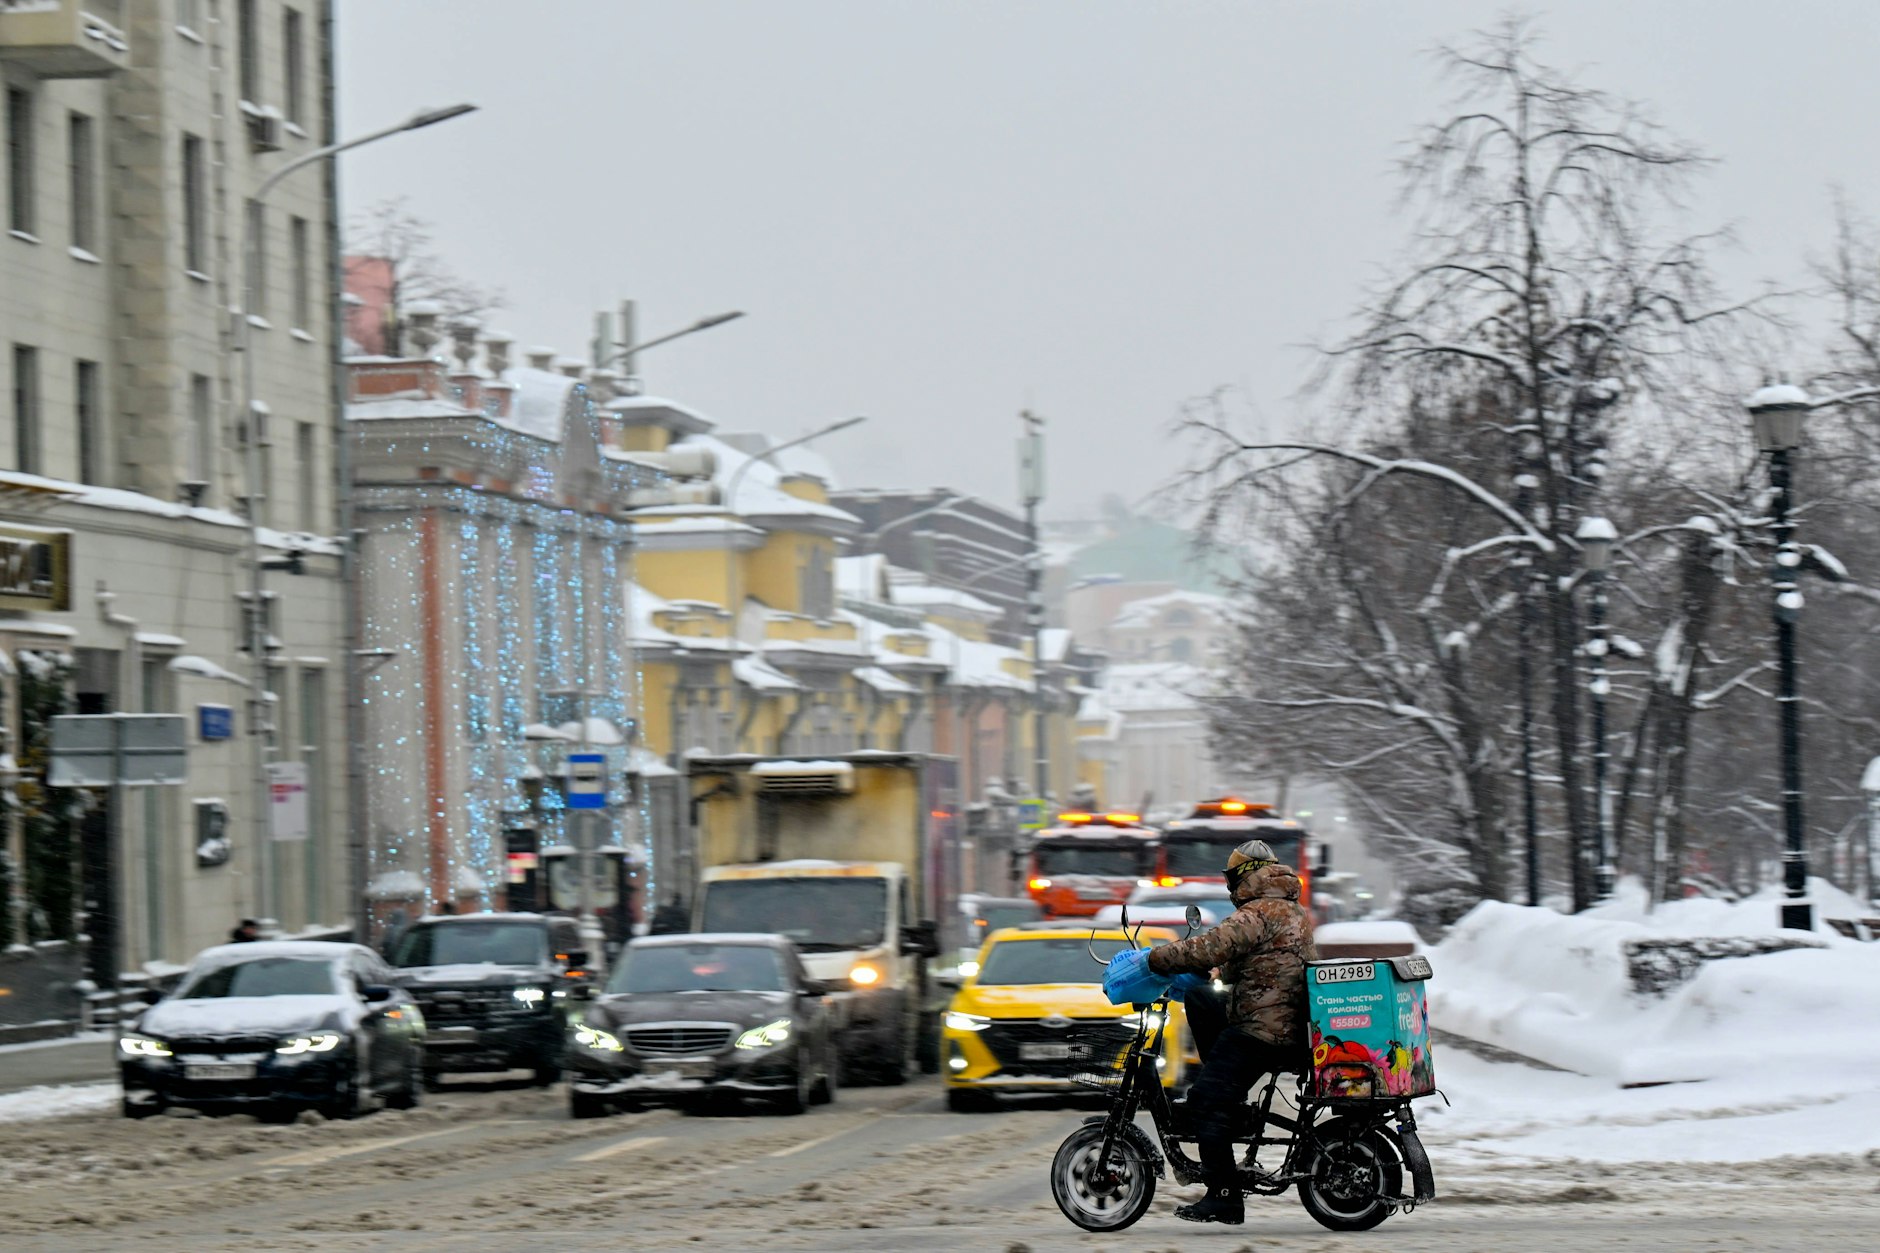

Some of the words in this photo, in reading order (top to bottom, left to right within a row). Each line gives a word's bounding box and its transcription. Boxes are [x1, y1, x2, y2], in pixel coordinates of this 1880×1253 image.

[1318, 966, 1372, 981] ОН2989
[1316, 996, 1345, 1006] Стань
[1346, 994, 1383, 1003] частью
[1327, 1005, 1372, 1014] команды
[1398, 1004, 1420, 1031] fresh
